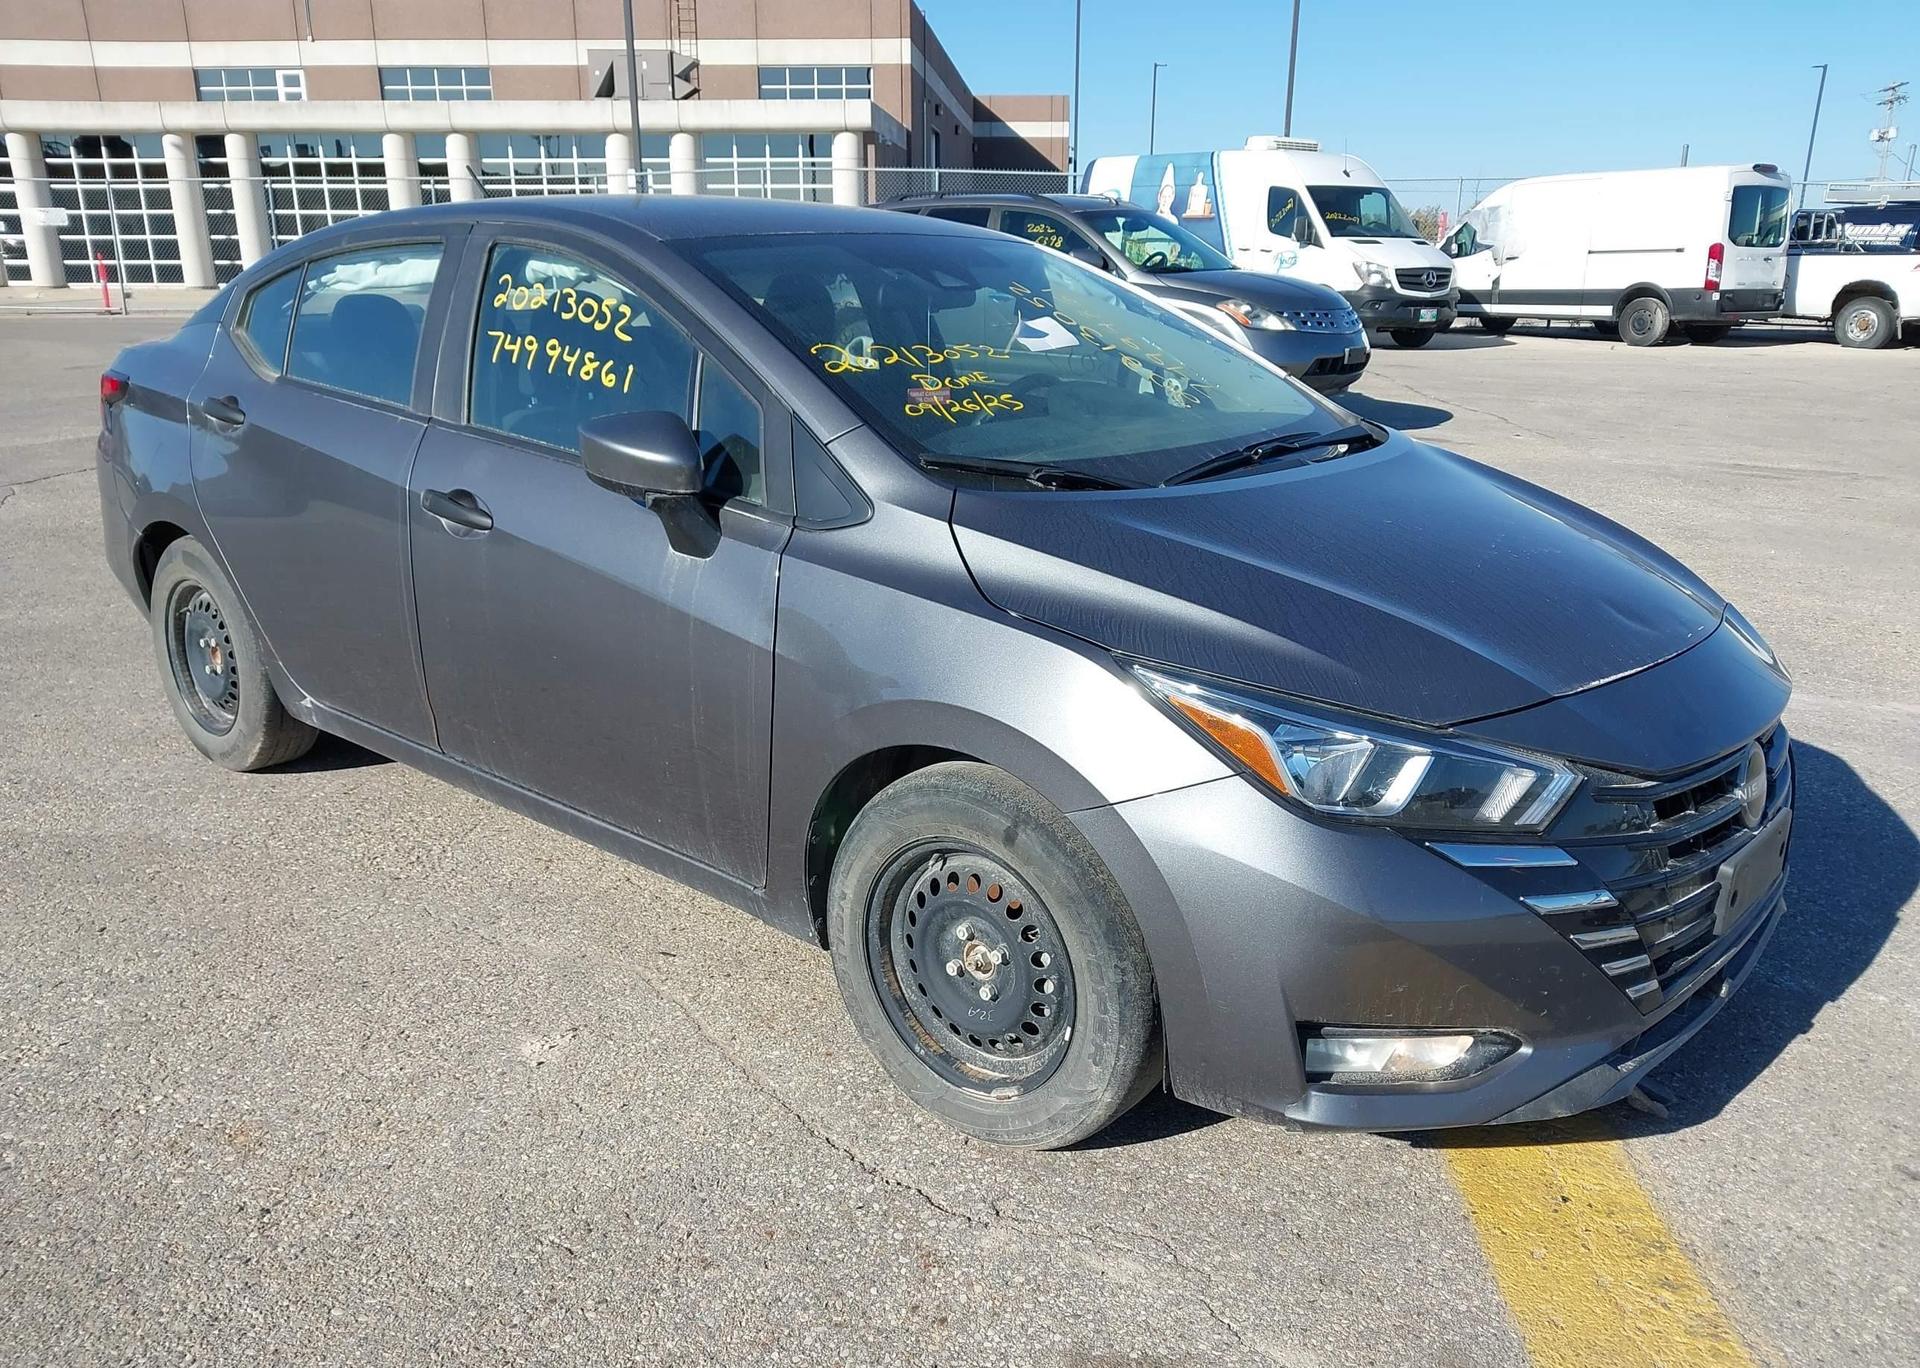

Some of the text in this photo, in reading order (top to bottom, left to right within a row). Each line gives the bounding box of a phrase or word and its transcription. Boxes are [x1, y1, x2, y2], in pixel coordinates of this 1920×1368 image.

[1027, 223, 1056, 233] 2022
[494, 274, 633, 342] 20213052
[487, 331, 634, 394] 74994861
[810, 343, 1010, 373] 20213052
[905, 391, 1025, 424] 09/26/25
